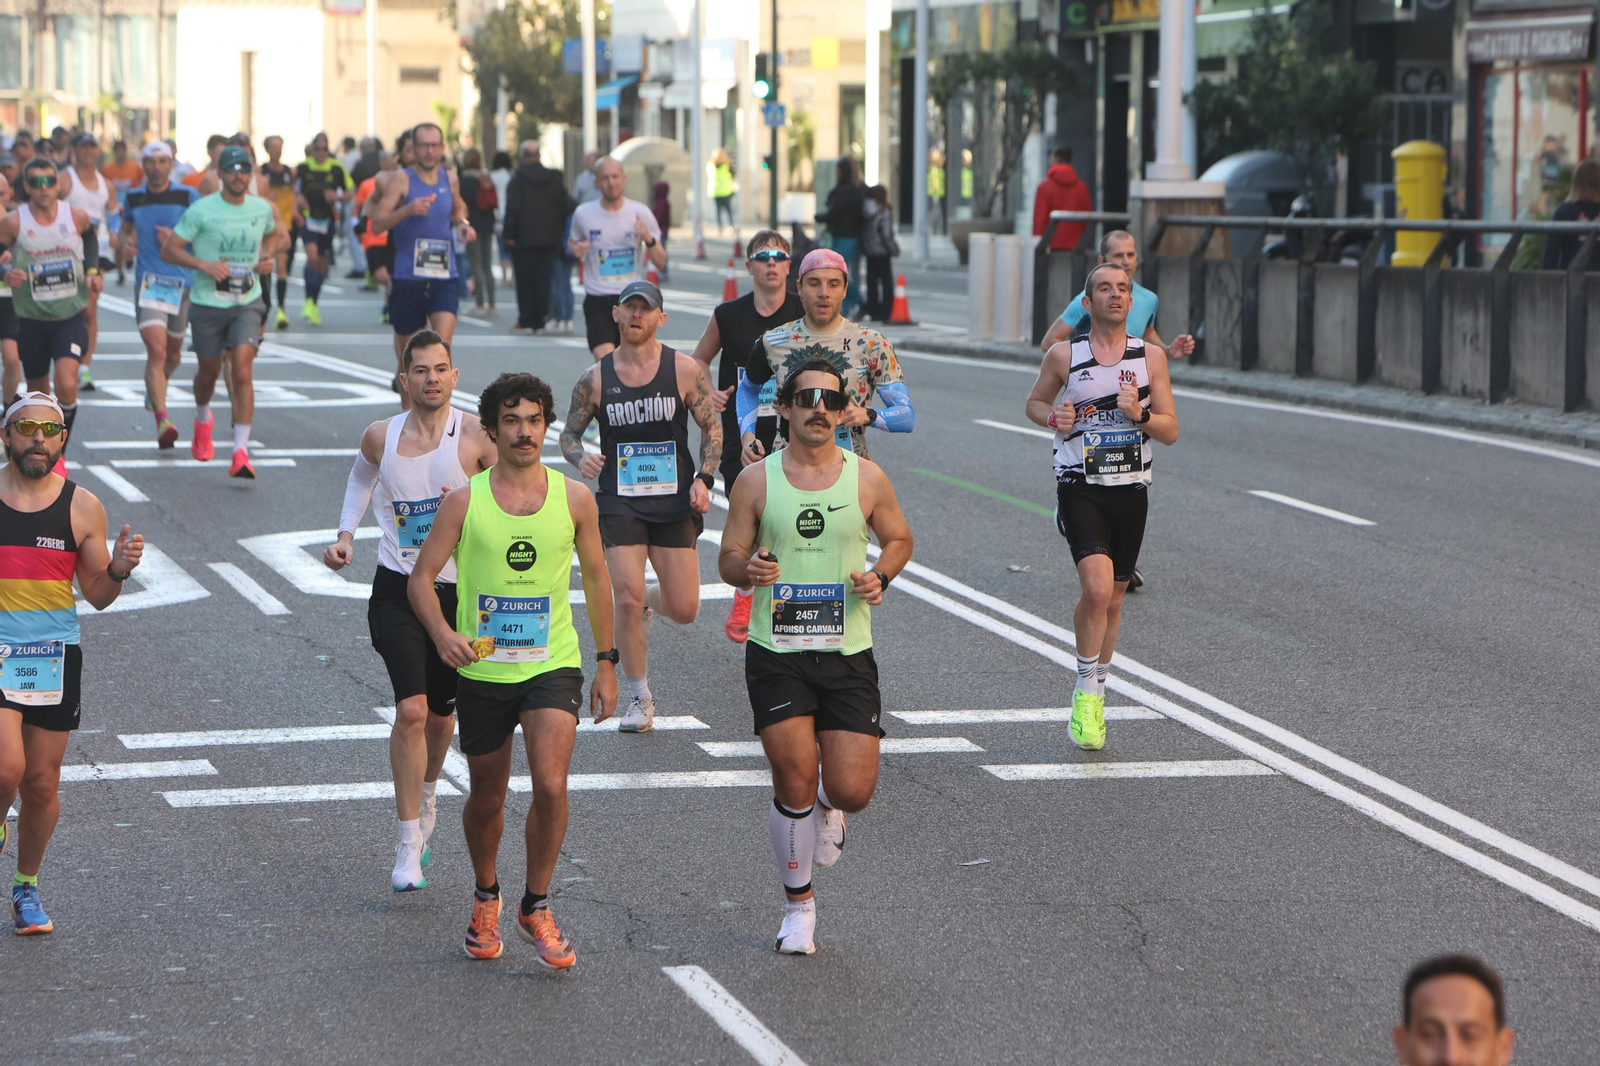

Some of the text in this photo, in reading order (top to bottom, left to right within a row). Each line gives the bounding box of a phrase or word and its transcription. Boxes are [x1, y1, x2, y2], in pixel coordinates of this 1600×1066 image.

[842, 338, 852, 351] K
[606, 392, 676, 426] GROCHÓW
[1105, 434, 1135, 443] ZURICH
[1105, 453, 1124, 462] 2558
[638, 464, 656, 472] 4092
[1120, 464, 1132, 472] REY
[413, 502, 440, 513] ZURIC
[417, 523, 432, 534] 400
[36, 536, 65, 550] 226ERS
[796, 588, 835, 597] ZURICH
[502, 602, 541, 610] ZURICH
[796, 610, 819, 620] 2457
[501, 624, 523, 633] 4471
[774, 625, 842, 633] AFONSO CARVALH
[16, 646, 55, 655] ZURICH
[15, 667, 38, 677] 3586
